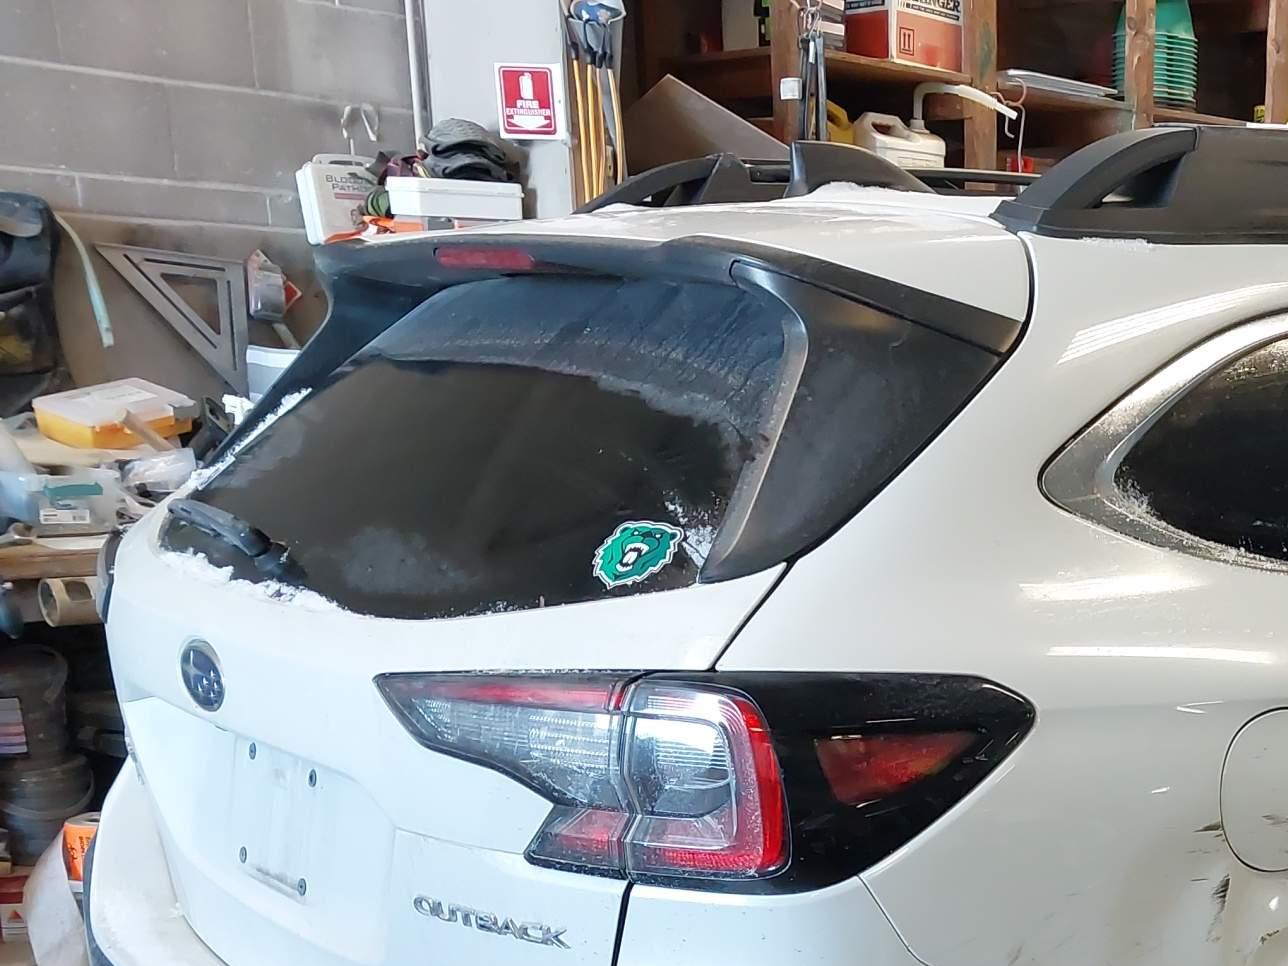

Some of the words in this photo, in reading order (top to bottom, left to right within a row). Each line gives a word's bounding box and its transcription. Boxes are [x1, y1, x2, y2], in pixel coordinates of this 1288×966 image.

[516, 100, 540, 109] FIRE
[505, 107, 551, 116] EXTINGUISHER
[413, 896, 571, 950] OUTBACK
